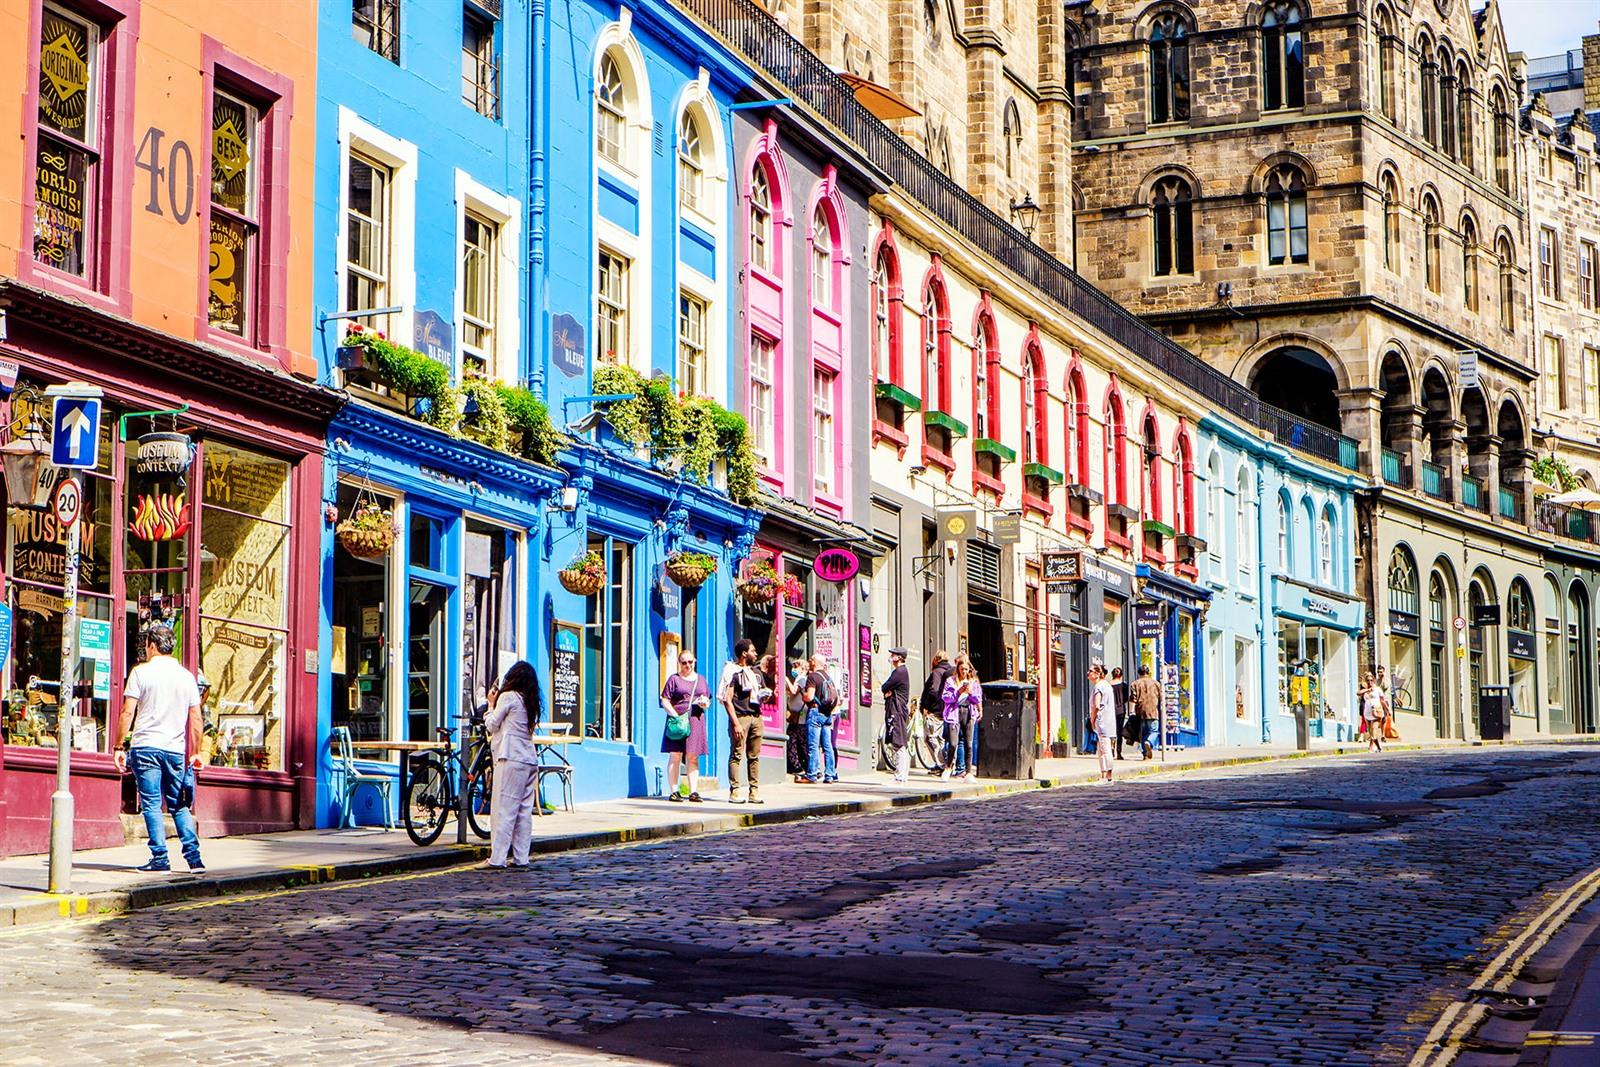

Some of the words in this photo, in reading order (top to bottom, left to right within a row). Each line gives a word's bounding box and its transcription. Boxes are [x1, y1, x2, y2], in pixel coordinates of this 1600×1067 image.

[45, 50, 83, 85] ORIGINAL
[217, 136, 242, 160] BEST
[135, 127, 194, 225] 40
[35, 184, 81, 214] AMOUS!
[428, 344, 452, 367] BLEUE
[565, 348, 584, 368] BLEUE
[138, 444, 179, 459] MUSEUM
[39, 468, 54, 489] 40
[137, 461, 179, 474] CONTEXT
[59, 494, 77, 512] 20
[14, 507, 95, 561] MUSEM
[29, 549, 65, 575] CONTE
[212, 557, 276, 600] MUSEUM
[1107, 571, 1122, 587] SHOP
[35, 592, 52, 606] HARRY
[224, 591, 264, 614] CONTEXT
